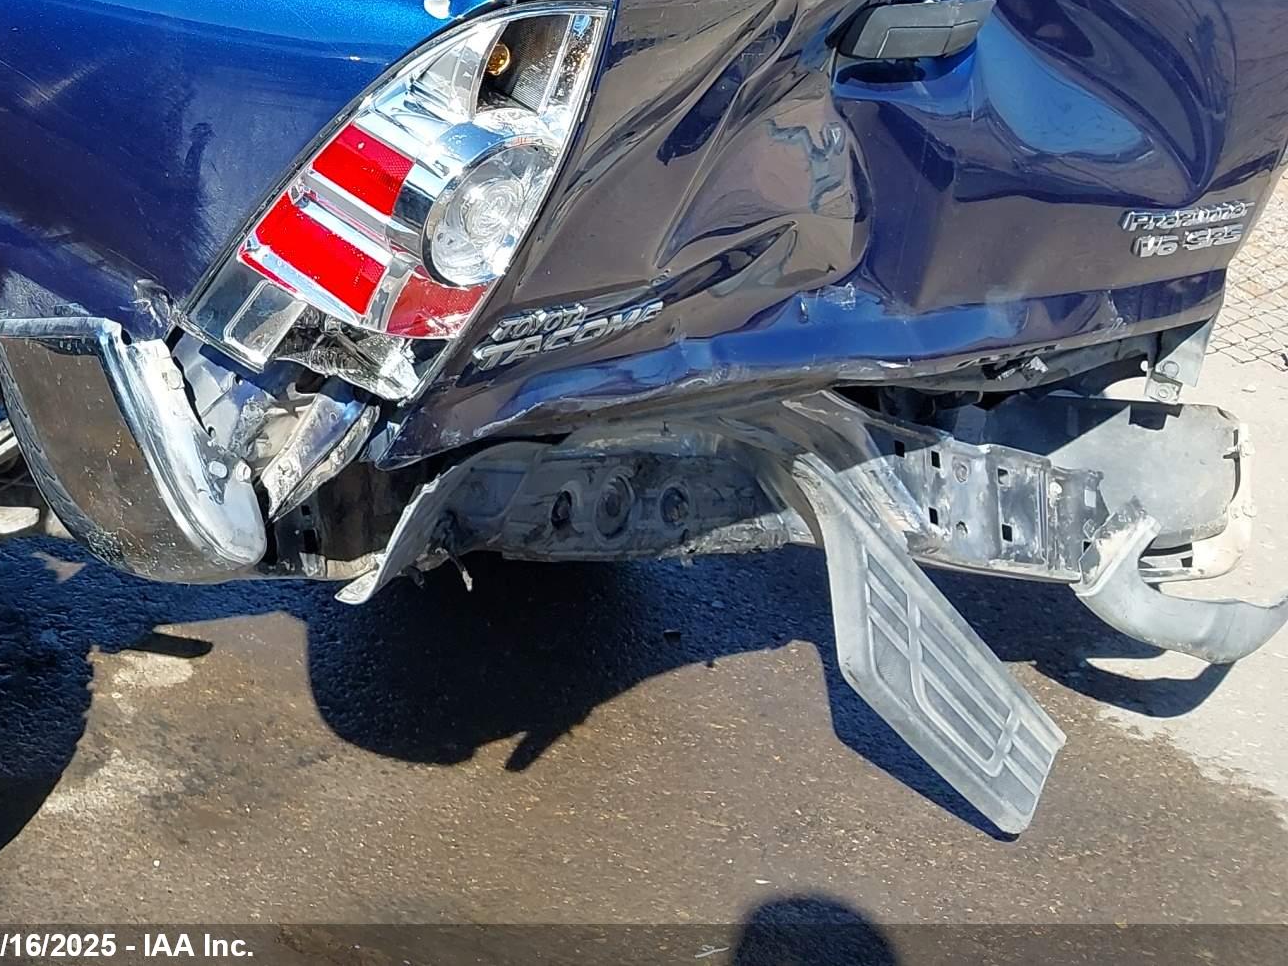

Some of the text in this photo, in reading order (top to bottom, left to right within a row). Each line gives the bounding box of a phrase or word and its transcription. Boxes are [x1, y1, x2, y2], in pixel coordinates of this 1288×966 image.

[1133, 223, 1244, 258] V6 SR5
[472, 299, 664, 372] TACOMA
[490, 302, 588, 342] TOYOTA
